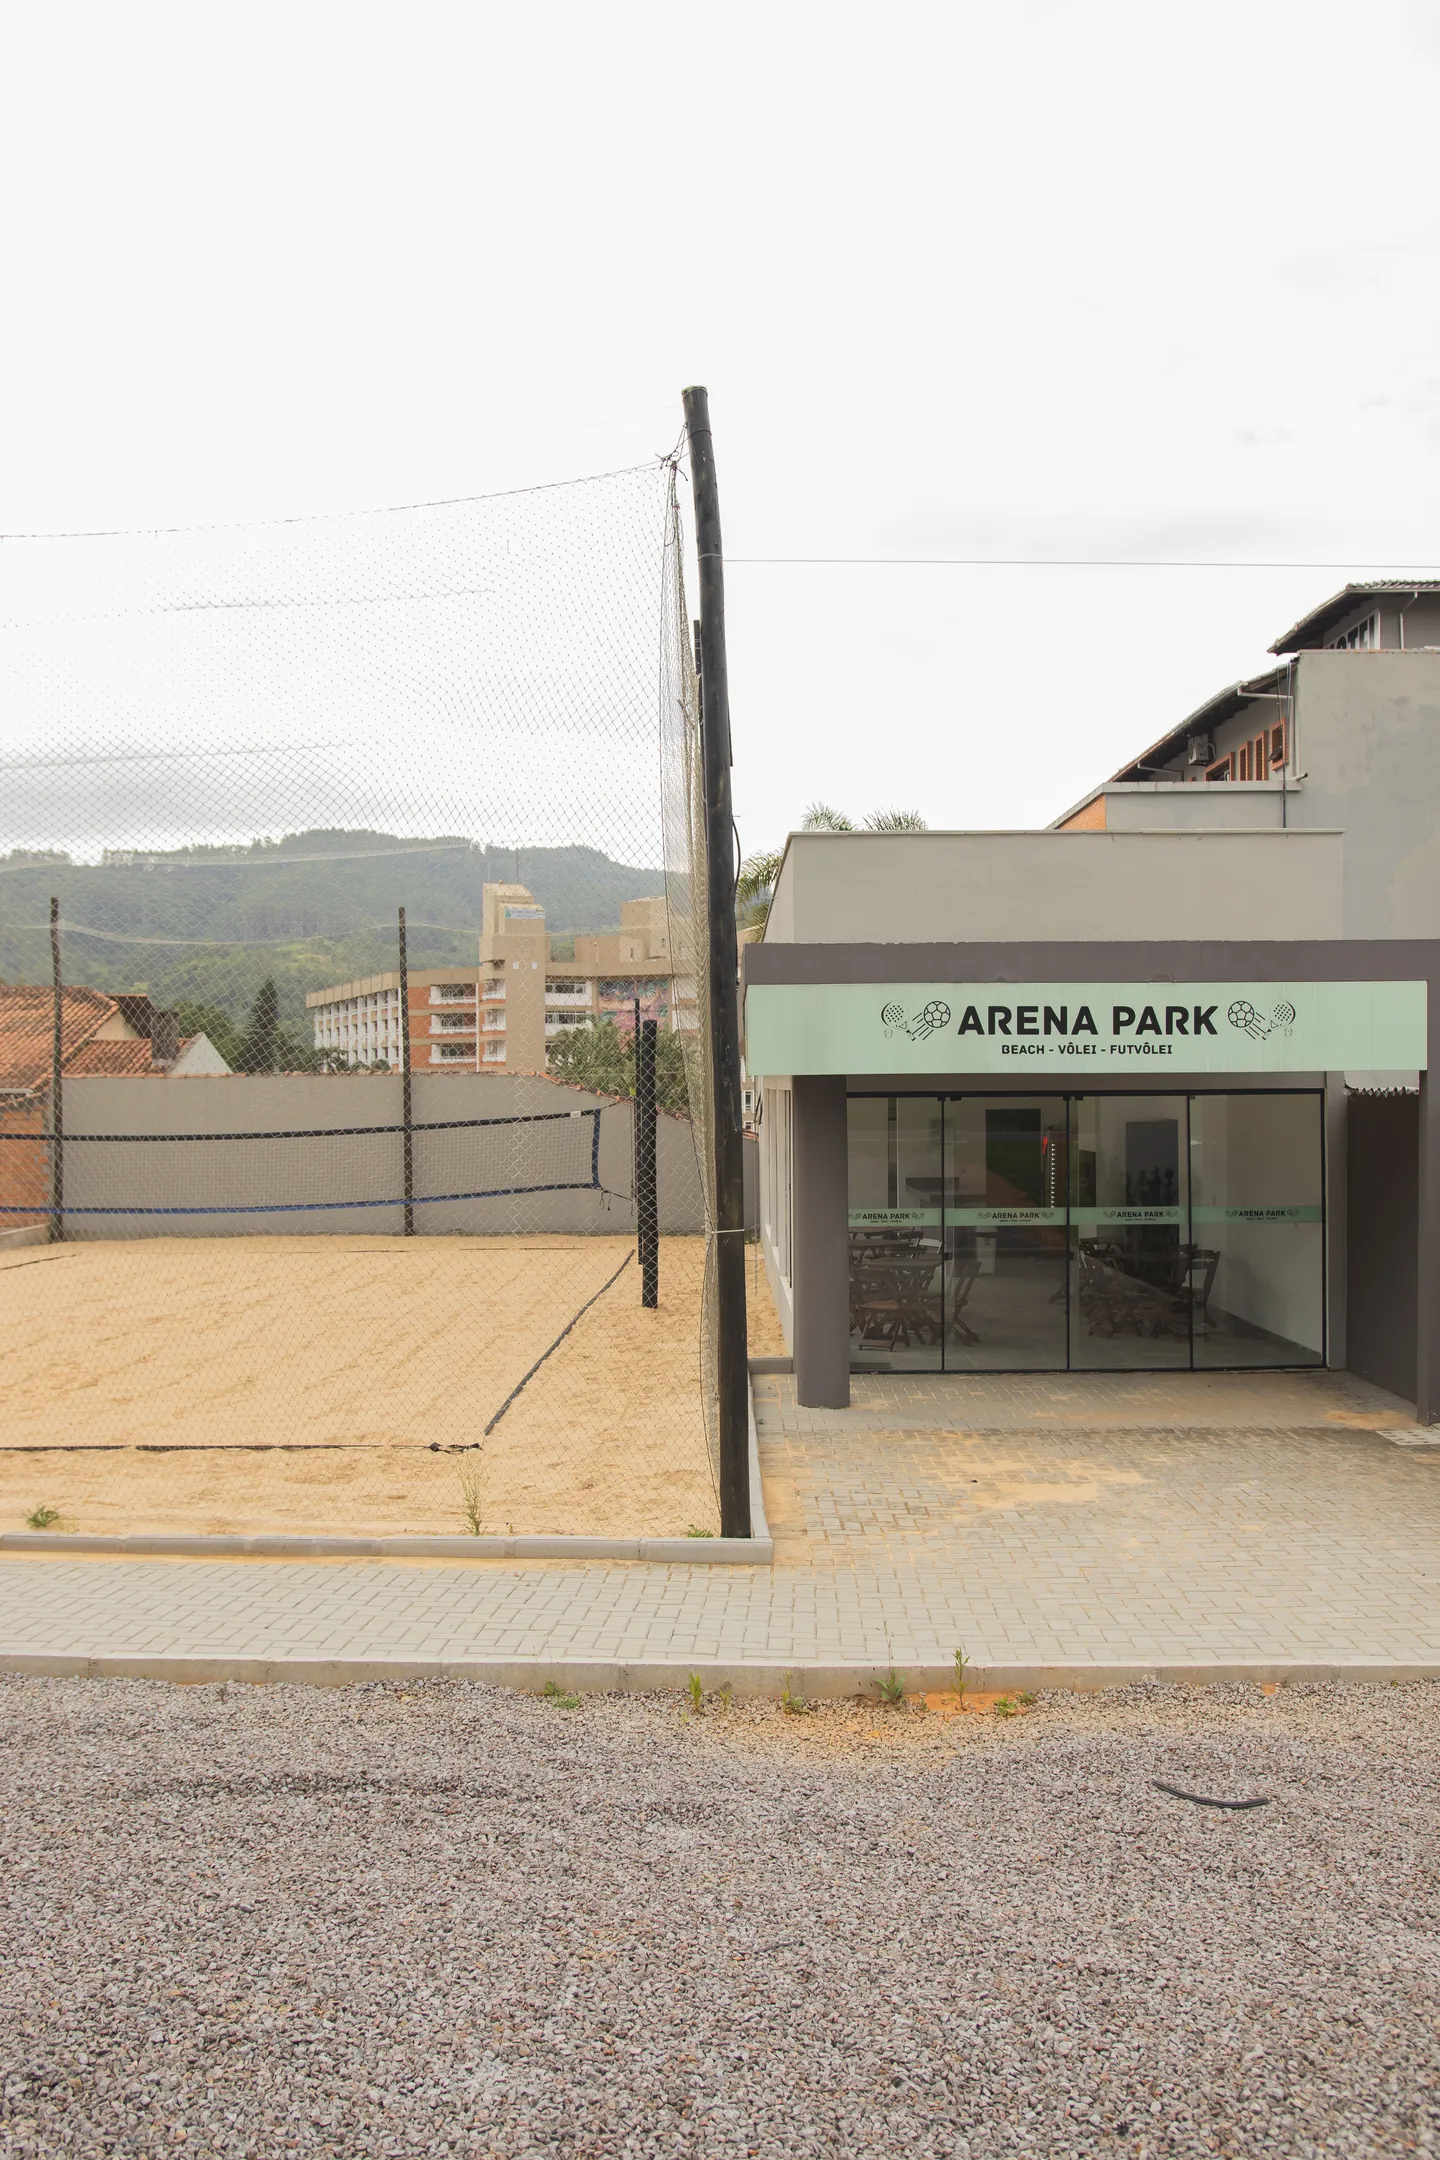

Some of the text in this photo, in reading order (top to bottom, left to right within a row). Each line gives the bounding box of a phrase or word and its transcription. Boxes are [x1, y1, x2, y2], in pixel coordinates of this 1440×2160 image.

[958, 1006, 1218, 1035] ARENA PARK
[1002, 1045, 1044, 1054] BEACH
[1058, 1042, 1096, 1054] VÔLEI
[1111, 1042, 1172, 1054] FUTVÔLEI
